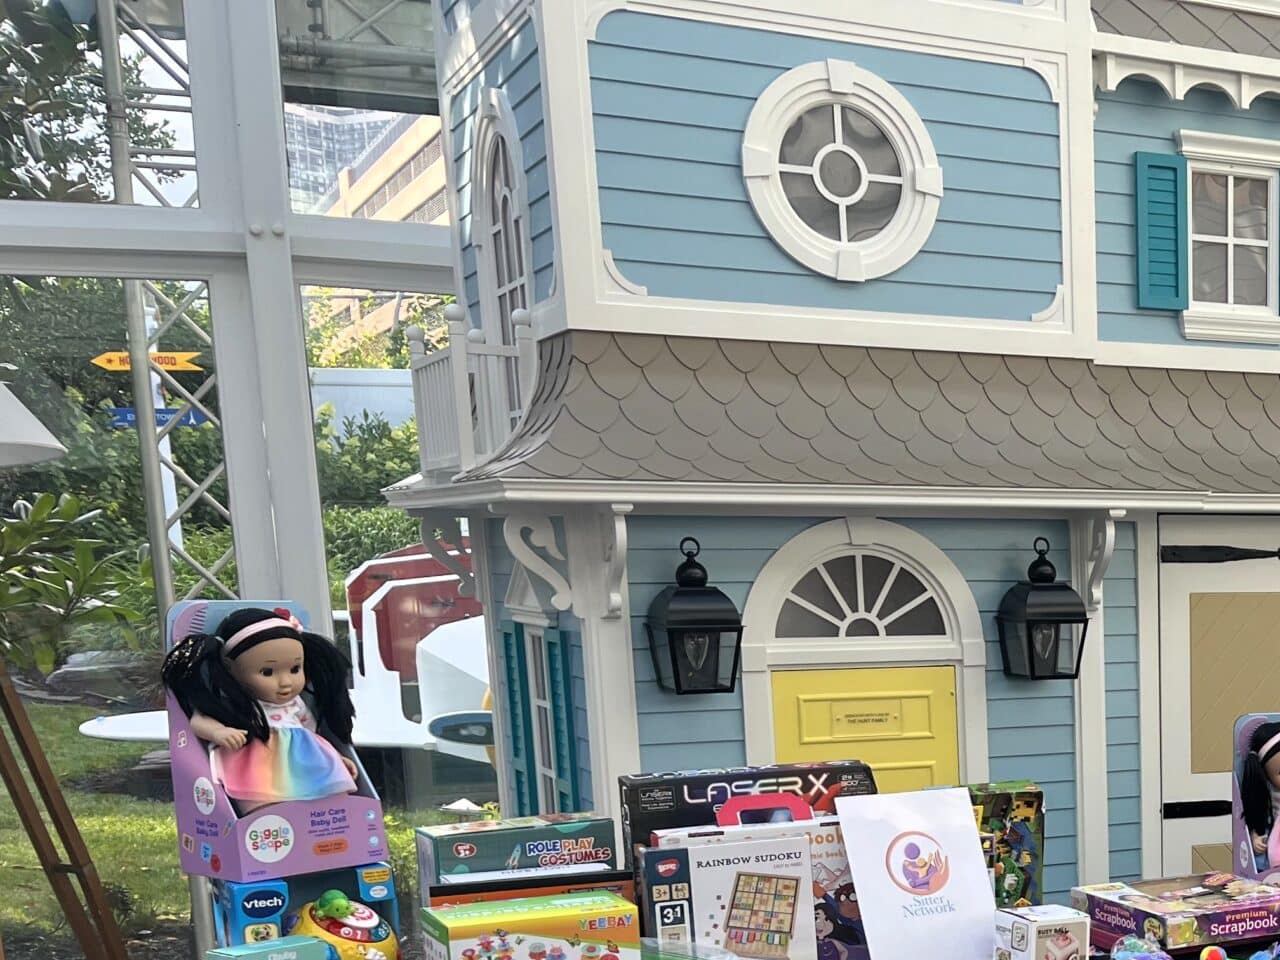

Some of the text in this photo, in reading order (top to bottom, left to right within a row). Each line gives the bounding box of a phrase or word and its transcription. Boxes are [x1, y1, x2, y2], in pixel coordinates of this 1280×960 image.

[118, 355, 177, 366] HOOOD
[683, 775, 802, 805] LASER
[808, 772, 829, 796] X
[310, 807, 346, 818] Hair Care
[310, 815, 347, 828] Baby Doll
[526, 836, 595, 857] ROLE PLAY
[539, 847, 612, 867] COSTUMES
[696, 851, 802, 869] RAINBOW SUDOKU
[243, 897, 283, 910] vtech
[901, 899, 956, 919] Network
[912, 895, 944, 907] Sitter
[578, 913, 634, 933] YEEBAY
[1094, 907, 1138, 931] Scrapbook
[1210, 913, 1278, 938] Scrapbook
[1225, 909, 1268, 923] Premium
